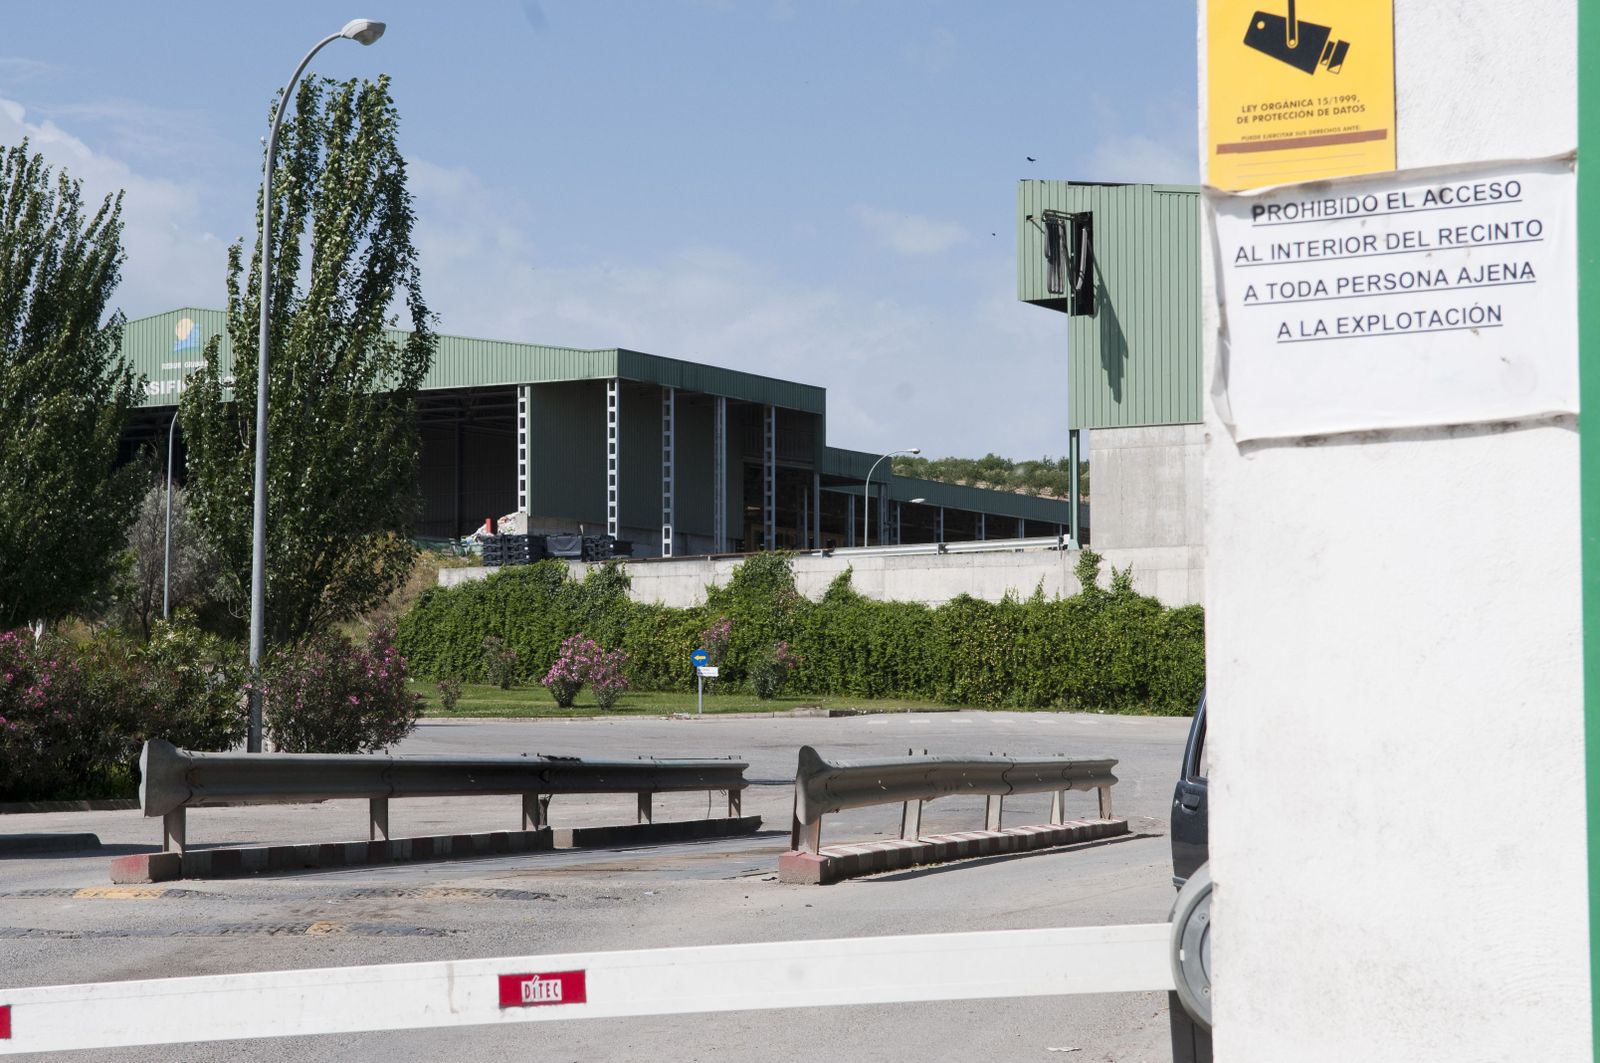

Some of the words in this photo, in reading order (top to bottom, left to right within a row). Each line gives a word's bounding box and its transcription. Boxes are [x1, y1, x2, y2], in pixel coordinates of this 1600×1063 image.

[1236, 115, 1249, 124] DE
[1317, 107, 1329, 117] DE
[1333, 104, 1366, 115] DATOS
[1242, 103, 1258, 113] LEY
[1252, 195, 1378, 222] PROHIBIDO
[1386, 192, 1415, 210] EL
[1422, 180, 1522, 207] ACCESO
[1235, 245, 1263, 263] AL
[1271, 235, 1378, 260] INTERIOR
[1386, 230, 1431, 250] DEL
[1438, 219, 1543, 245] RECINTO
[1244, 285, 1259, 301] A
[1266, 279, 1329, 300] TODA
[1337, 268, 1449, 294] PERSONA
[1457, 261, 1536, 284] AJENA
[1277, 322, 1292, 339] A
[1300, 319, 1329, 338] LA
[1337, 301, 1502, 335] EXPLOTACIÓN
